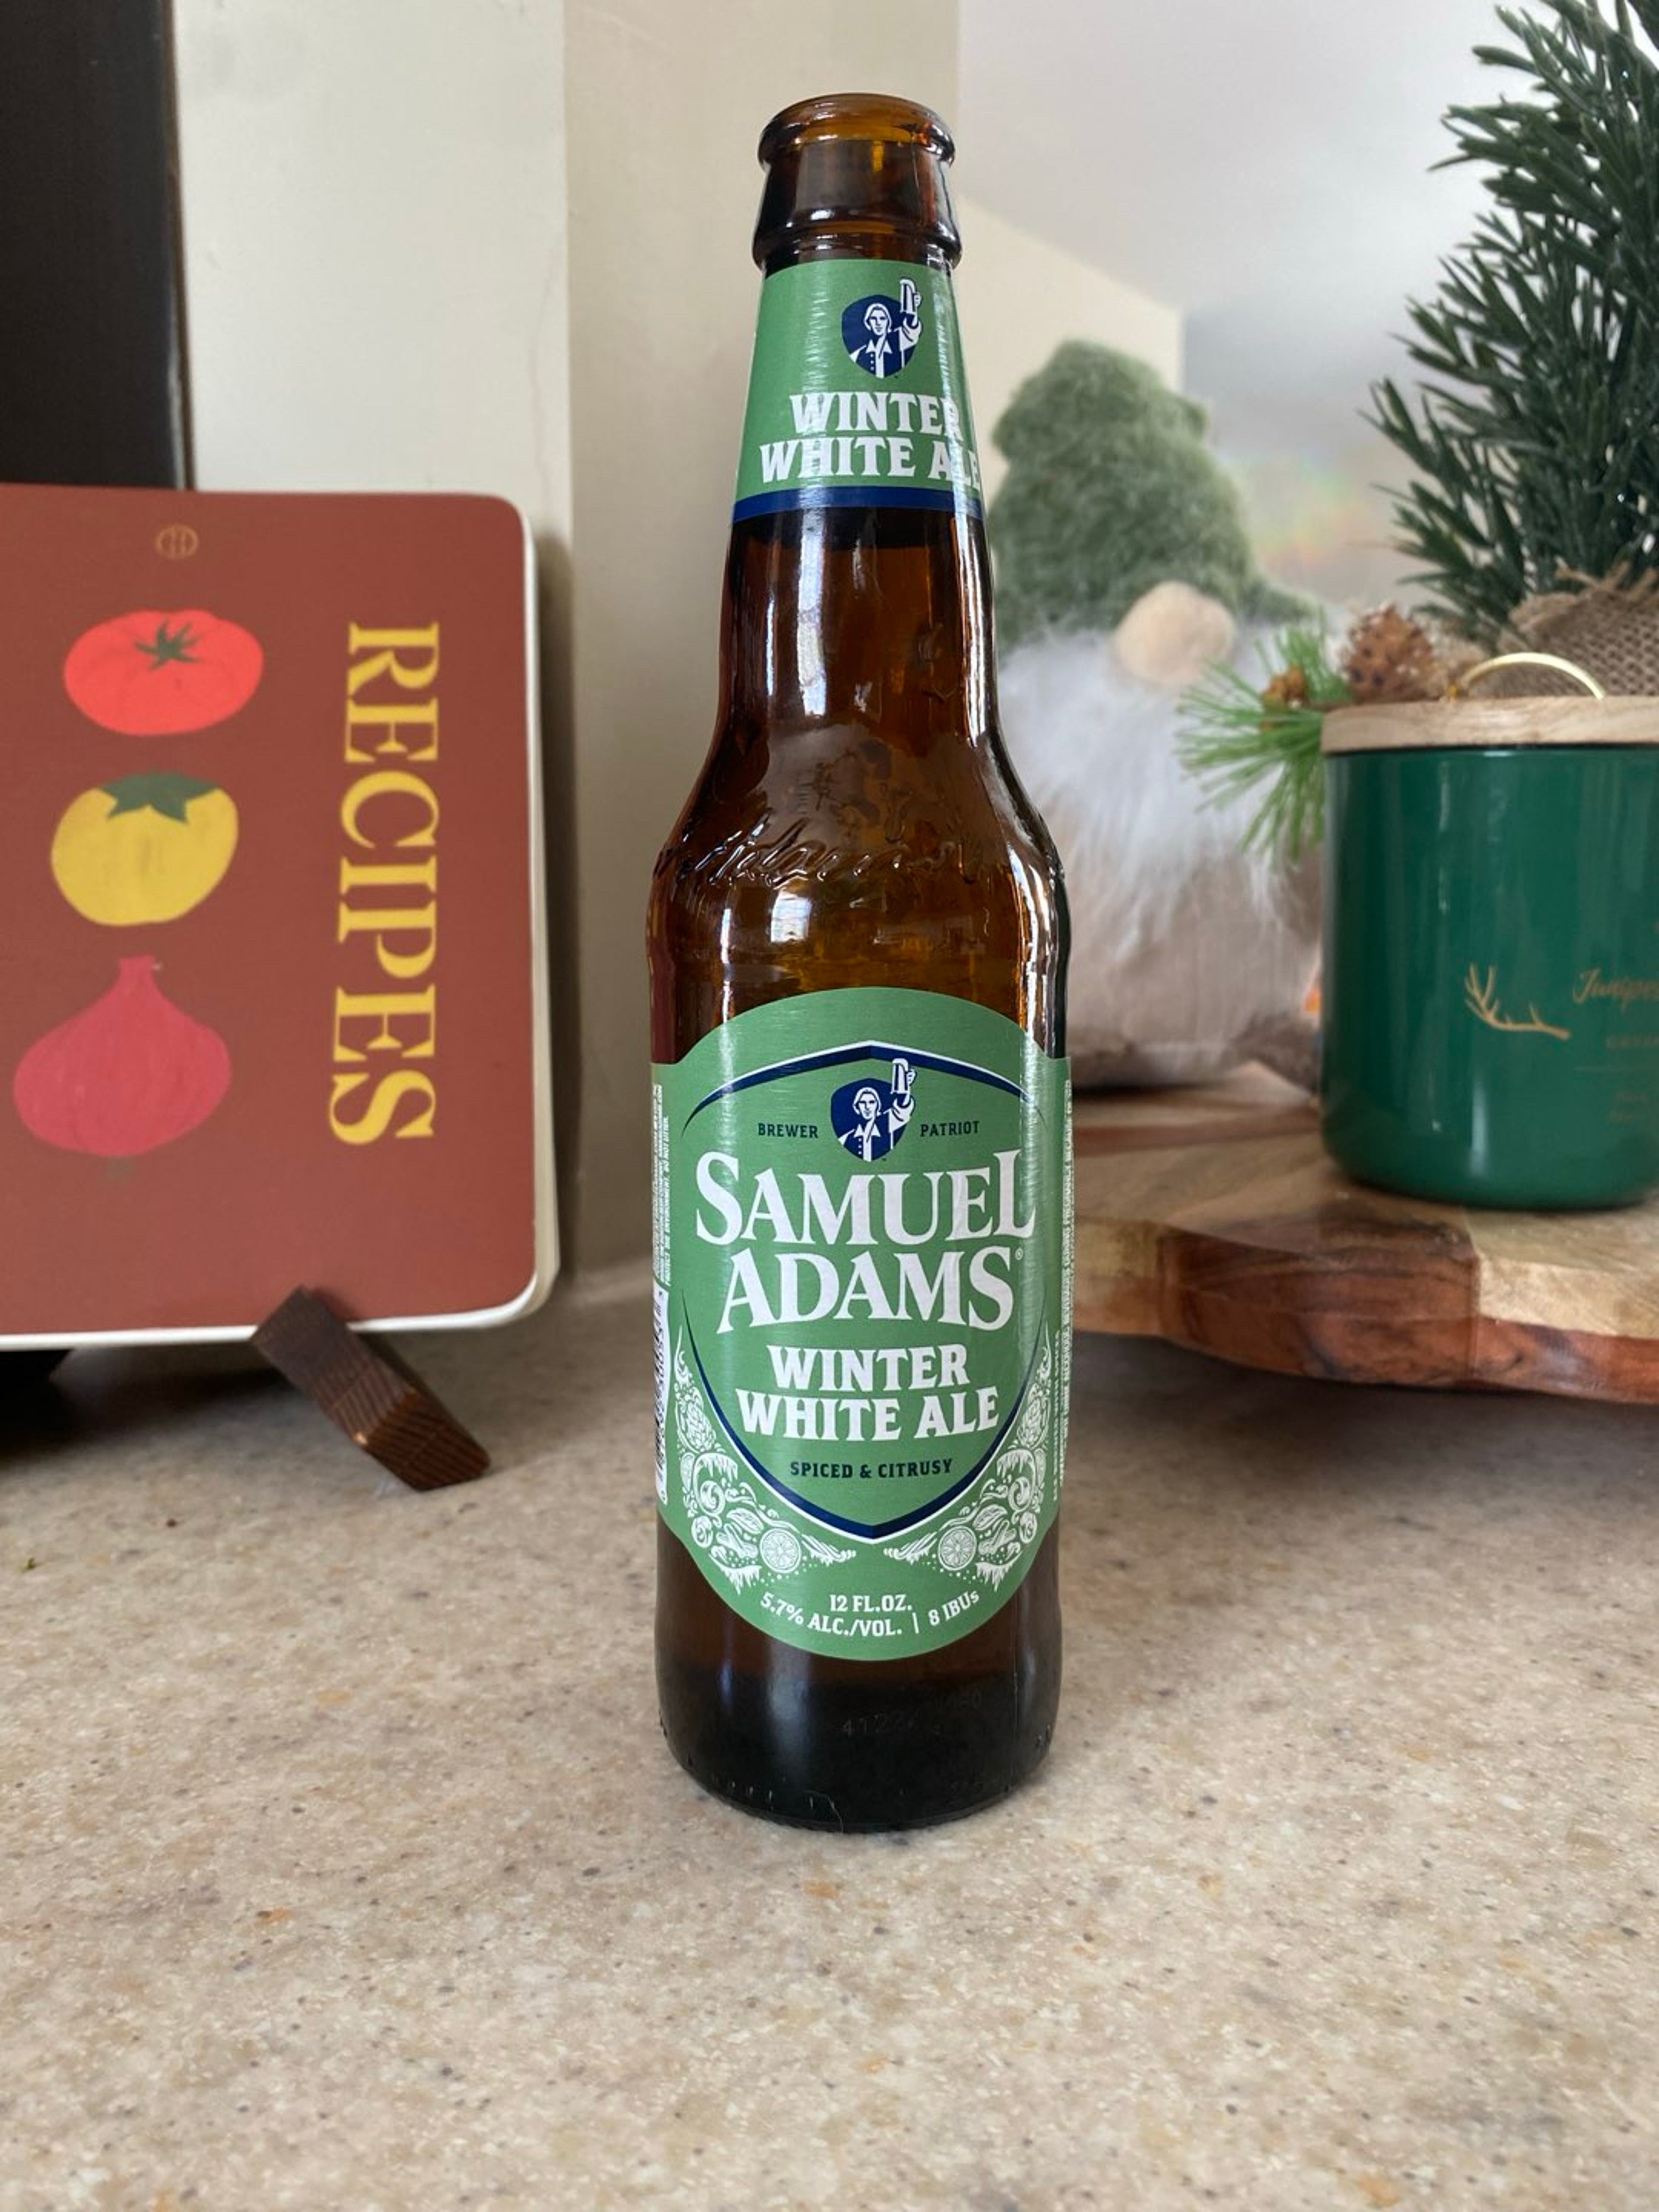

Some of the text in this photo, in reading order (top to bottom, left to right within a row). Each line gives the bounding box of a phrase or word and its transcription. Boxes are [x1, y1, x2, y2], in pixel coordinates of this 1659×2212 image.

[789, 392, 963, 442] WINTER
[760, 436, 916, 483] WHITE
[329, 622, 439, 1145] RECIPES
[758, 1121, 979, 1138] BREWER PATRIOT
[696, 1149, 1036, 1246] SAMUEL
[766, 1344, 970, 1392] WINTER
[736, 1388, 902, 1441] WHITE
[914, 1386, 999, 1439] ALE
[790, 1459, 953, 1479] SPICED & CITRUSY
[760, 1590, 979, 1637] 5.7% ALC./VOL. 8 IBUs
[830, 1594, 849, 1612] 12
